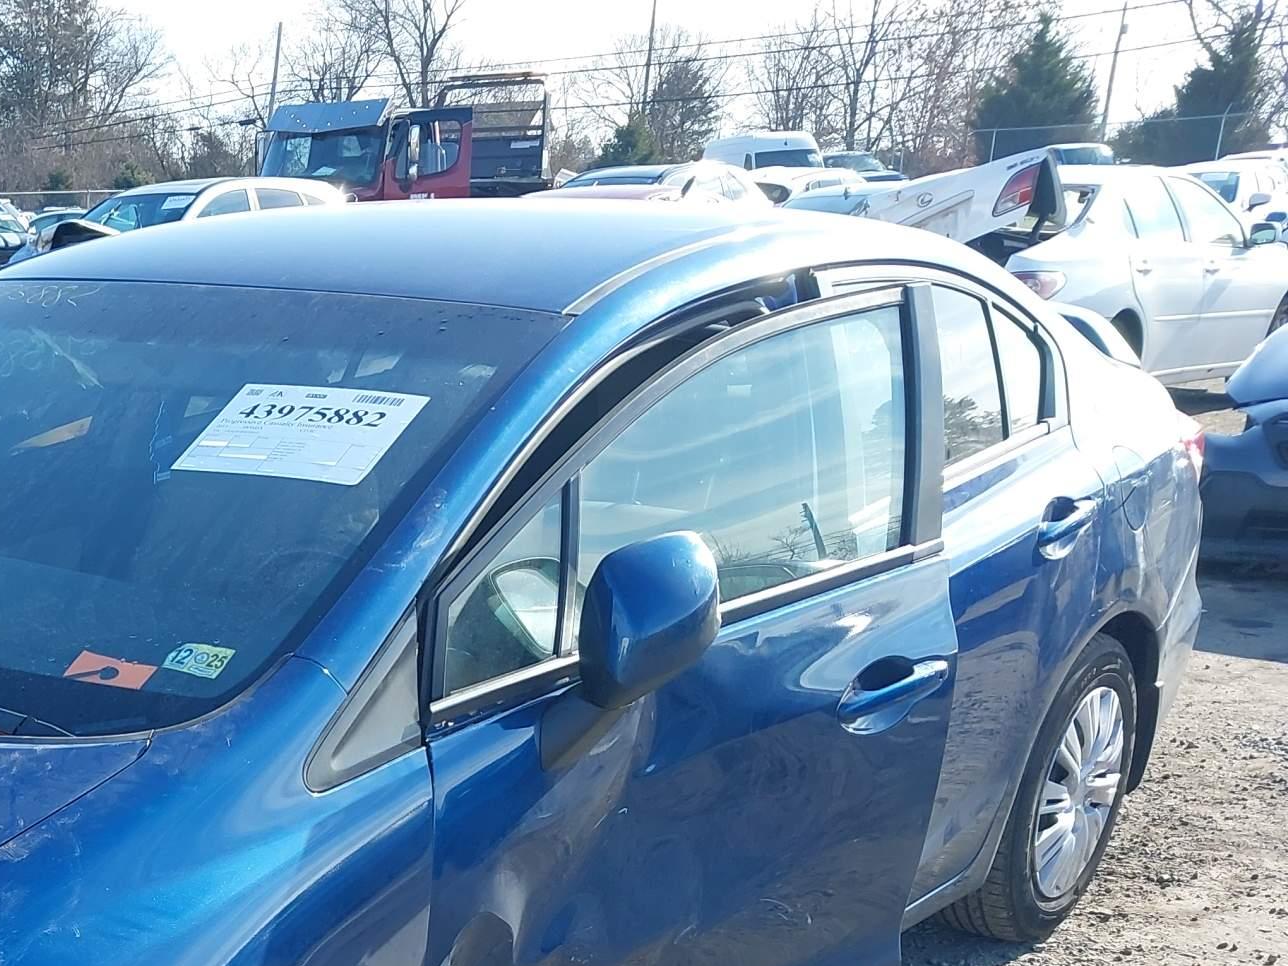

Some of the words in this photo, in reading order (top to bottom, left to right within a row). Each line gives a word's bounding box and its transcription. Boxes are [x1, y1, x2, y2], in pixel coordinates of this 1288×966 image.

[239, 403, 387, 428] 43975882
[170, 648, 194, 665] 12
[205, 653, 229, 670] 25
